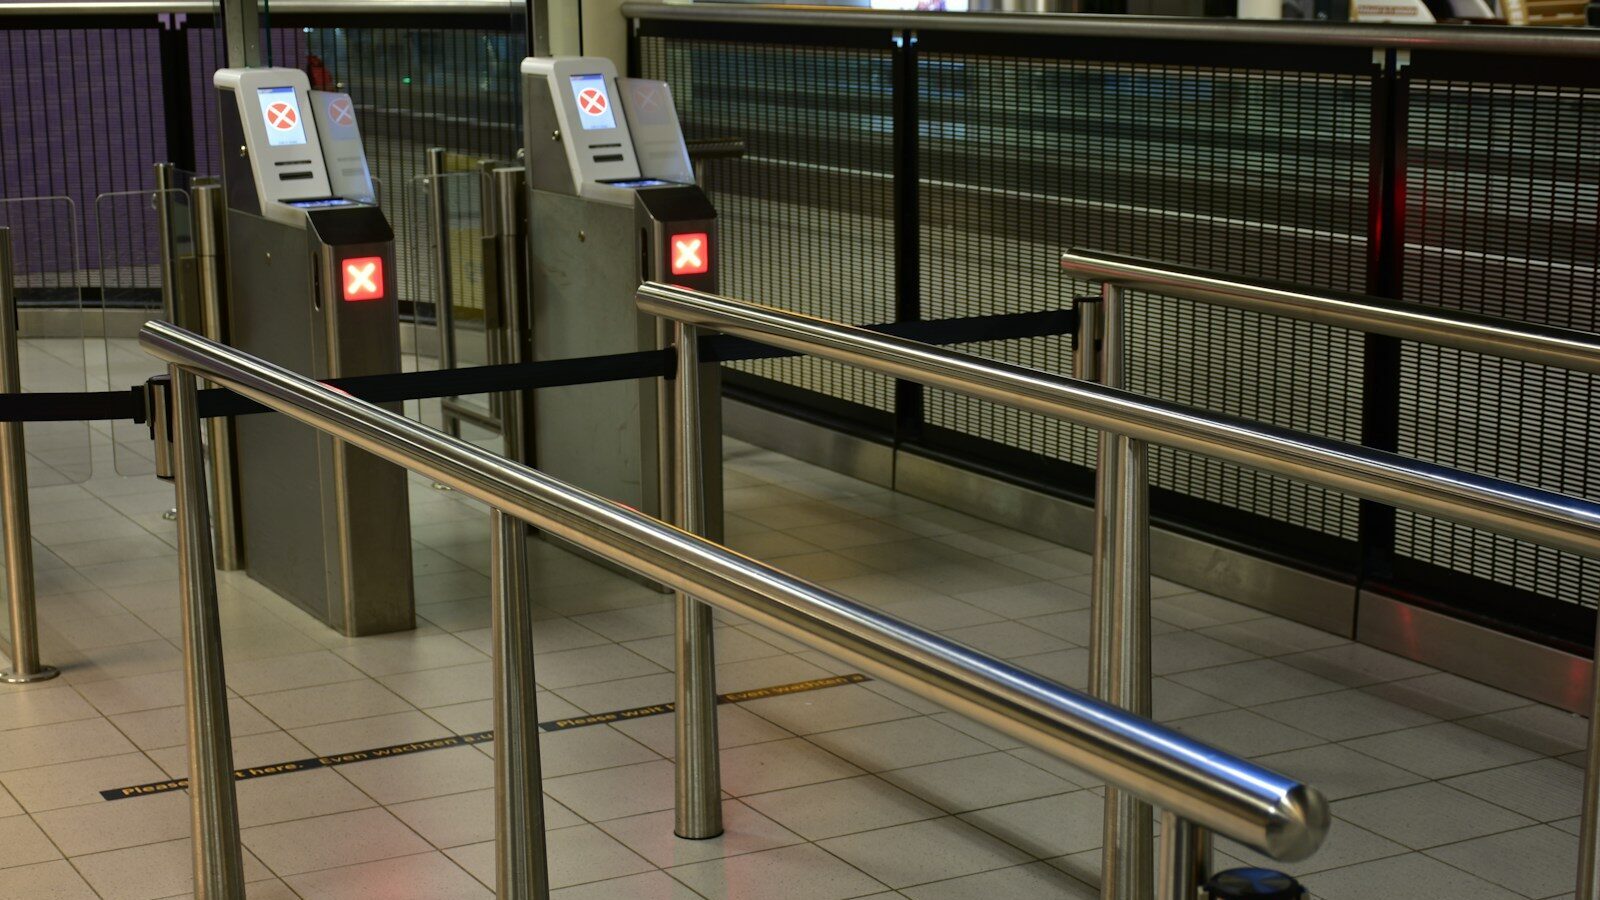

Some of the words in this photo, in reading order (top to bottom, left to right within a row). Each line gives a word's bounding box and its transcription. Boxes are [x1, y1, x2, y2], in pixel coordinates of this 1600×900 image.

[556, 713, 616, 728] Please
[621, 705, 664, 718] wait
[726, 689, 770, 700] Even
[773, 677, 848, 694] wachten
[121, 780, 188, 796] Please
[248, 763, 304, 776] here.
[319, 753, 368, 765] Even
[373, 738, 458, 756] wachten
